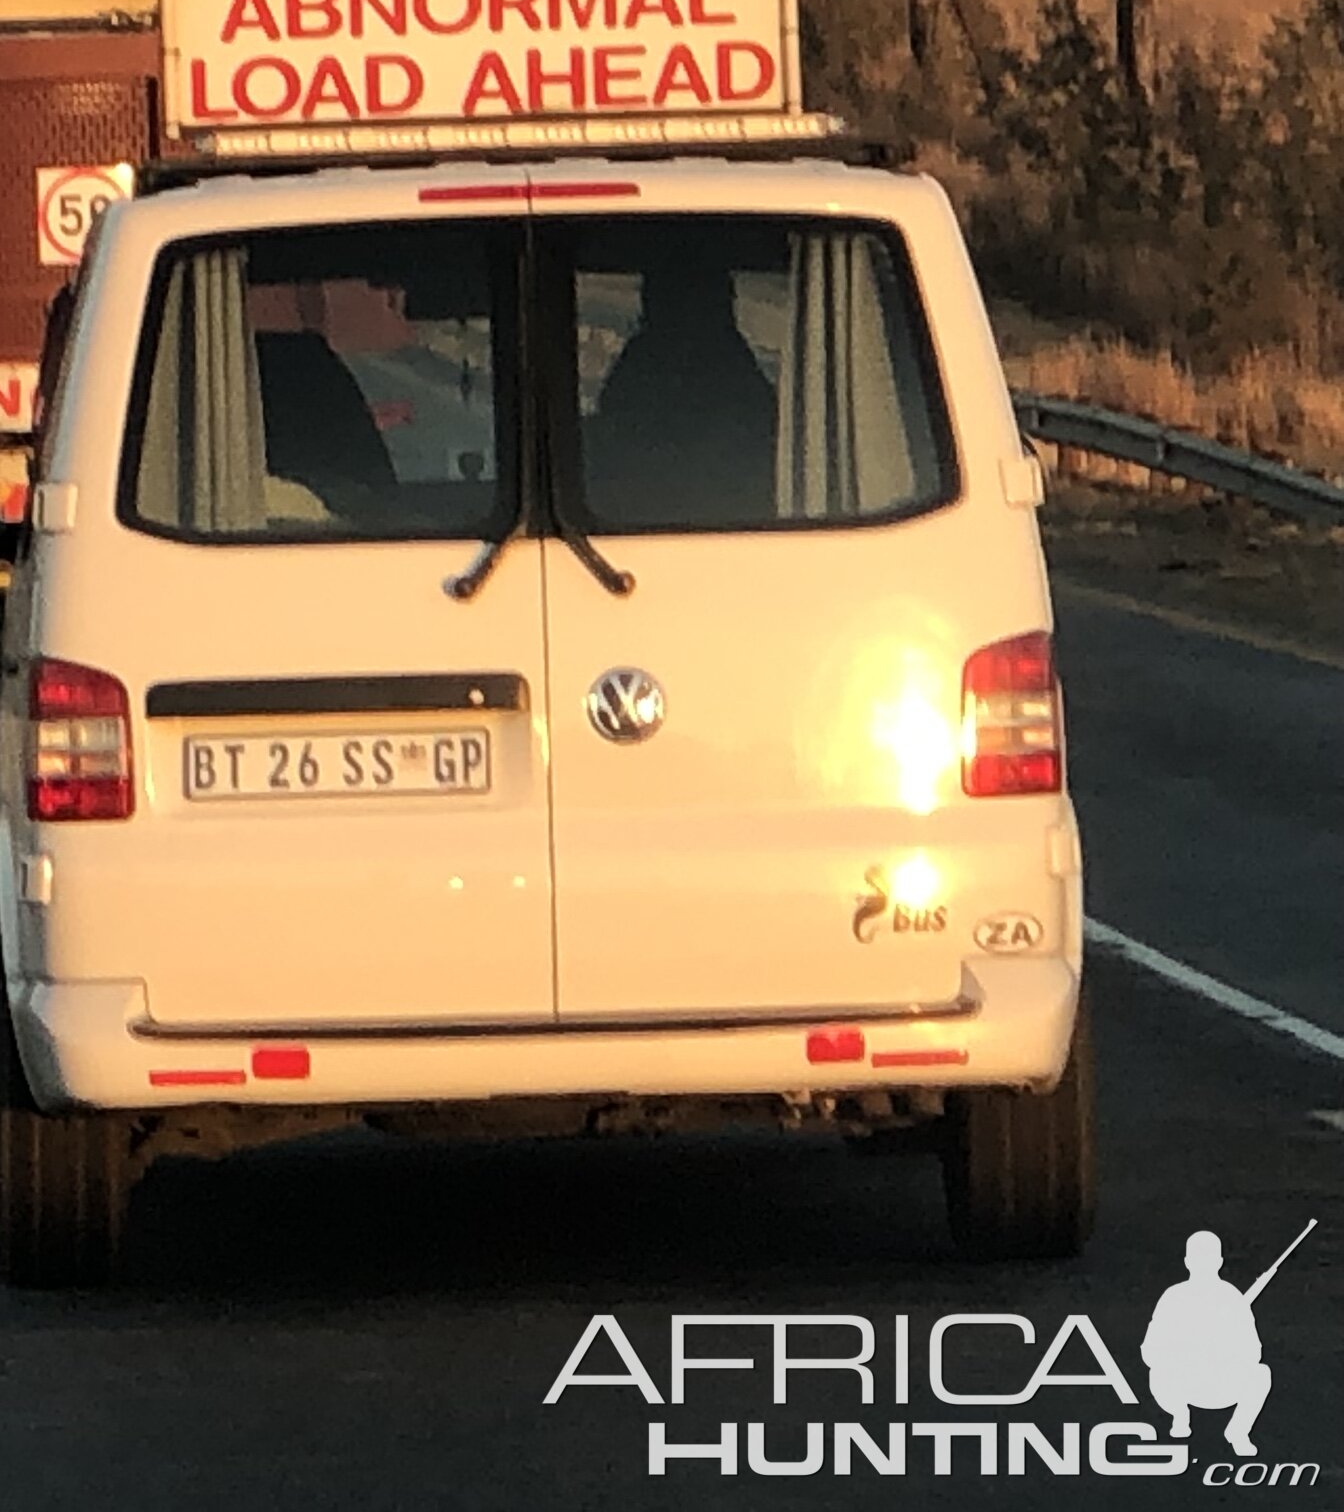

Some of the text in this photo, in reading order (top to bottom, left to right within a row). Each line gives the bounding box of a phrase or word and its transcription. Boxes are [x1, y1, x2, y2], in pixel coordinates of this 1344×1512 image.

[189, 41, 775, 120] LOAD AHEAD
[194, 736, 483, 790] BT 26 SS GP
[986, 921, 1033, 946] ZA
